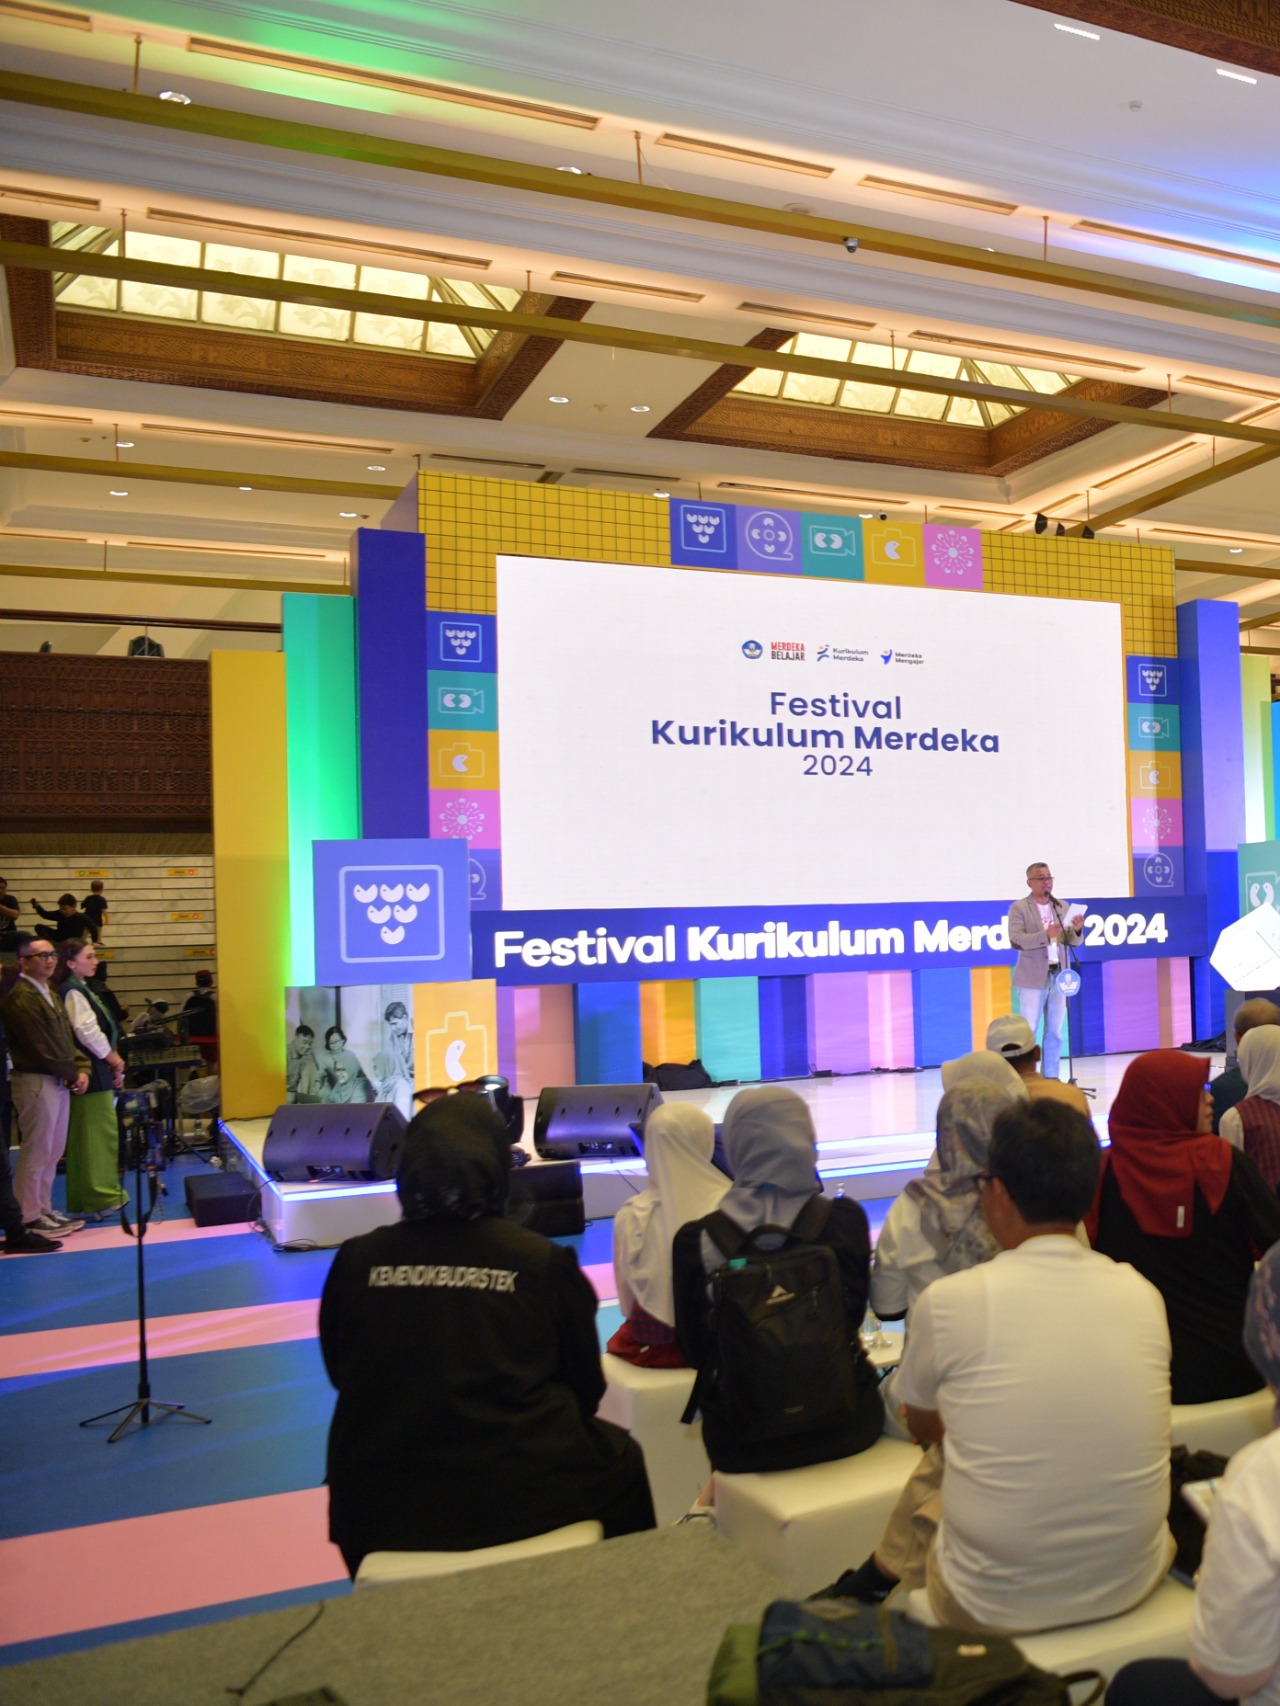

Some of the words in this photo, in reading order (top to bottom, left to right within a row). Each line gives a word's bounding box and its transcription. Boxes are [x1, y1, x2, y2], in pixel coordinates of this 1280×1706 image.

[770, 641, 806, 652] MERDEKA
[832, 647, 869, 655] Kurikulum
[770, 651, 806, 662] BELAJAR
[832, 655, 865, 663] Merdeka
[894, 651, 923, 659] Merdeka
[894, 657, 925, 666] Mengajar
[770, 691, 902, 720] Festival
[651, 719, 845, 749] Kurikulum
[853, 726, 1000, 753] Merdeka
[802, 754, 874, 777] 2024
[494, 924, 676, 968] Festival
[687, 920, 905, 962] Kurikulum
[913, 916, 1013, 953] Merd
[1084, 912, 1168, 947] 2024
